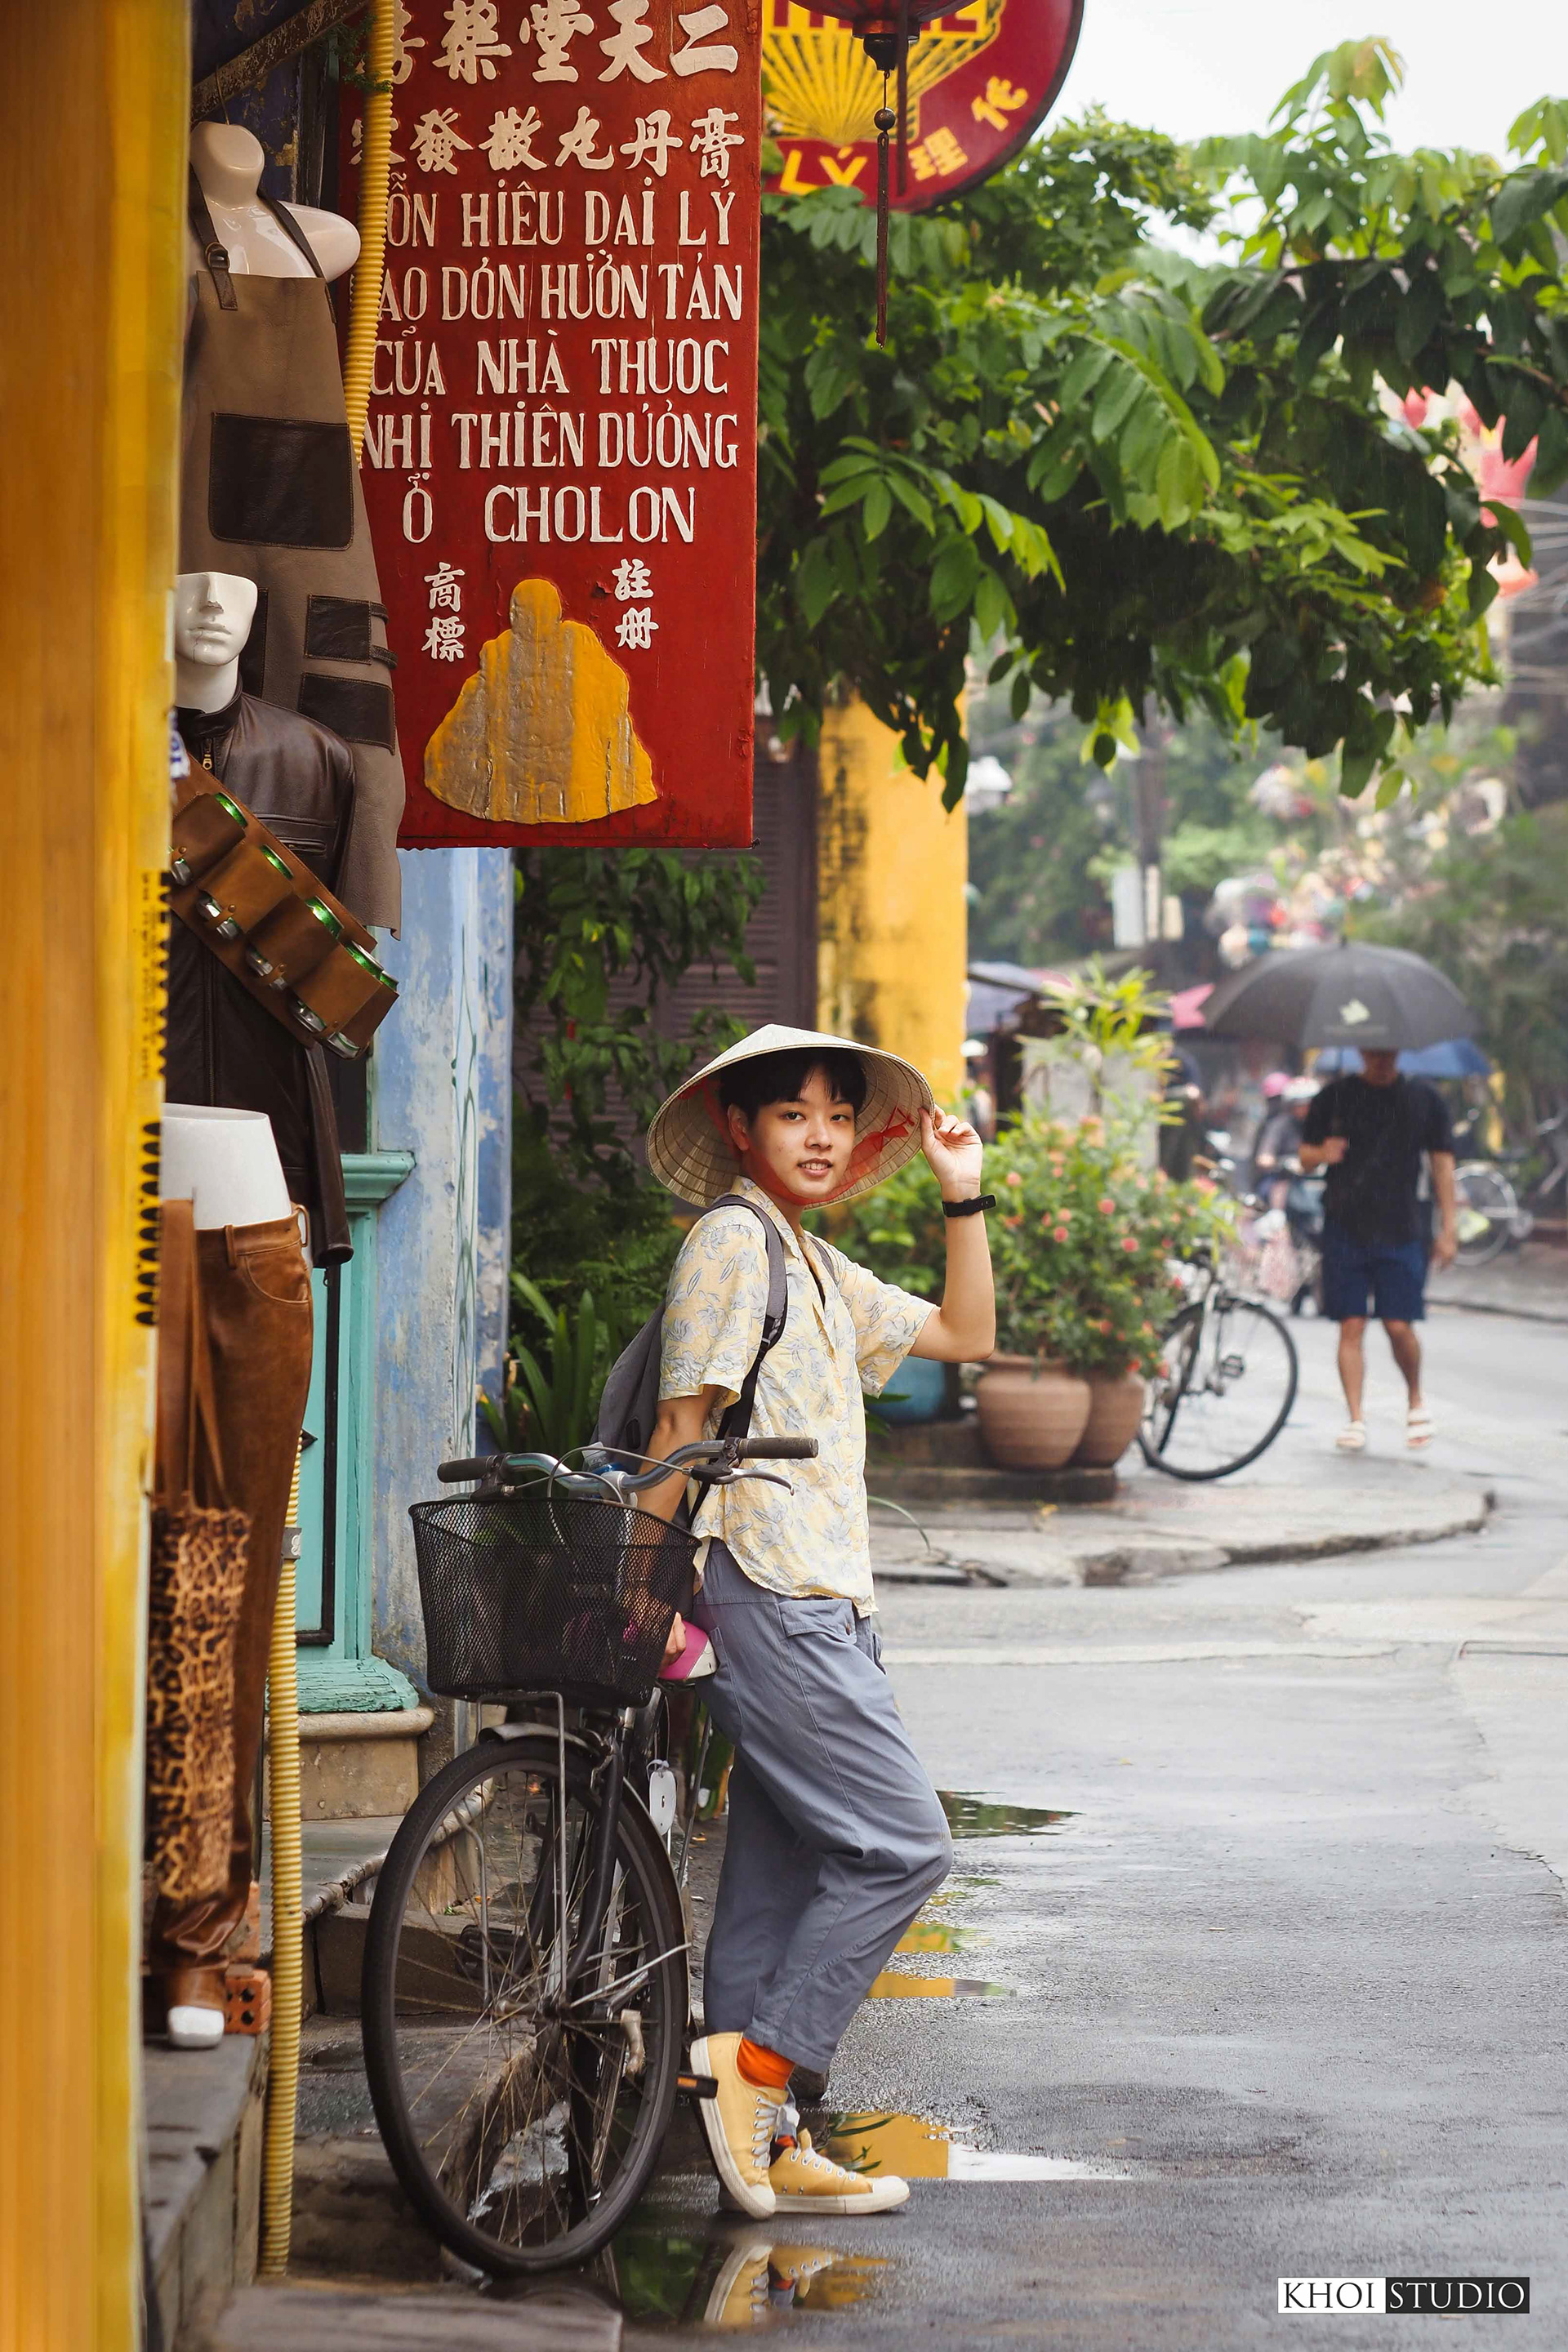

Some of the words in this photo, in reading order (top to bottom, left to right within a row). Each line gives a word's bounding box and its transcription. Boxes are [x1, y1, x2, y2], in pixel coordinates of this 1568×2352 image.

[679, 179, 736, 246] LÝ
[657, 252, 742, 321] TÁN
[476, 328, 570, 395] NHÀ
[591, 336, 728, 395] THUOC
[451, 400, 585, 469] THIÊN
